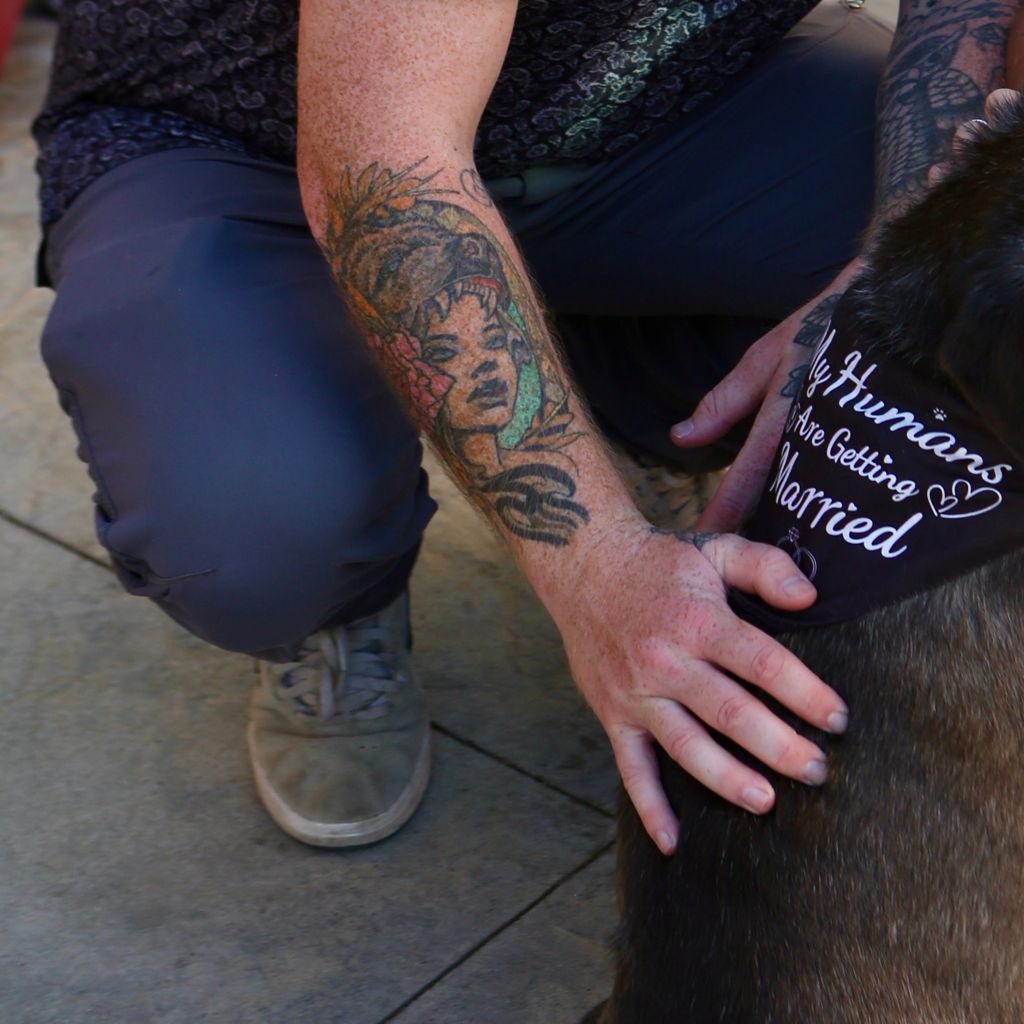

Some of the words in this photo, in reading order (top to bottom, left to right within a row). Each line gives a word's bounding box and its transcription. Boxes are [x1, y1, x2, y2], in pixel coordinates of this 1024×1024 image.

[794, 405, 825, 446] Are
[826, 428, 919, 502] Getting
[822, 350, 1013, 484] Humans
[769, 441, 923, 558] Married
